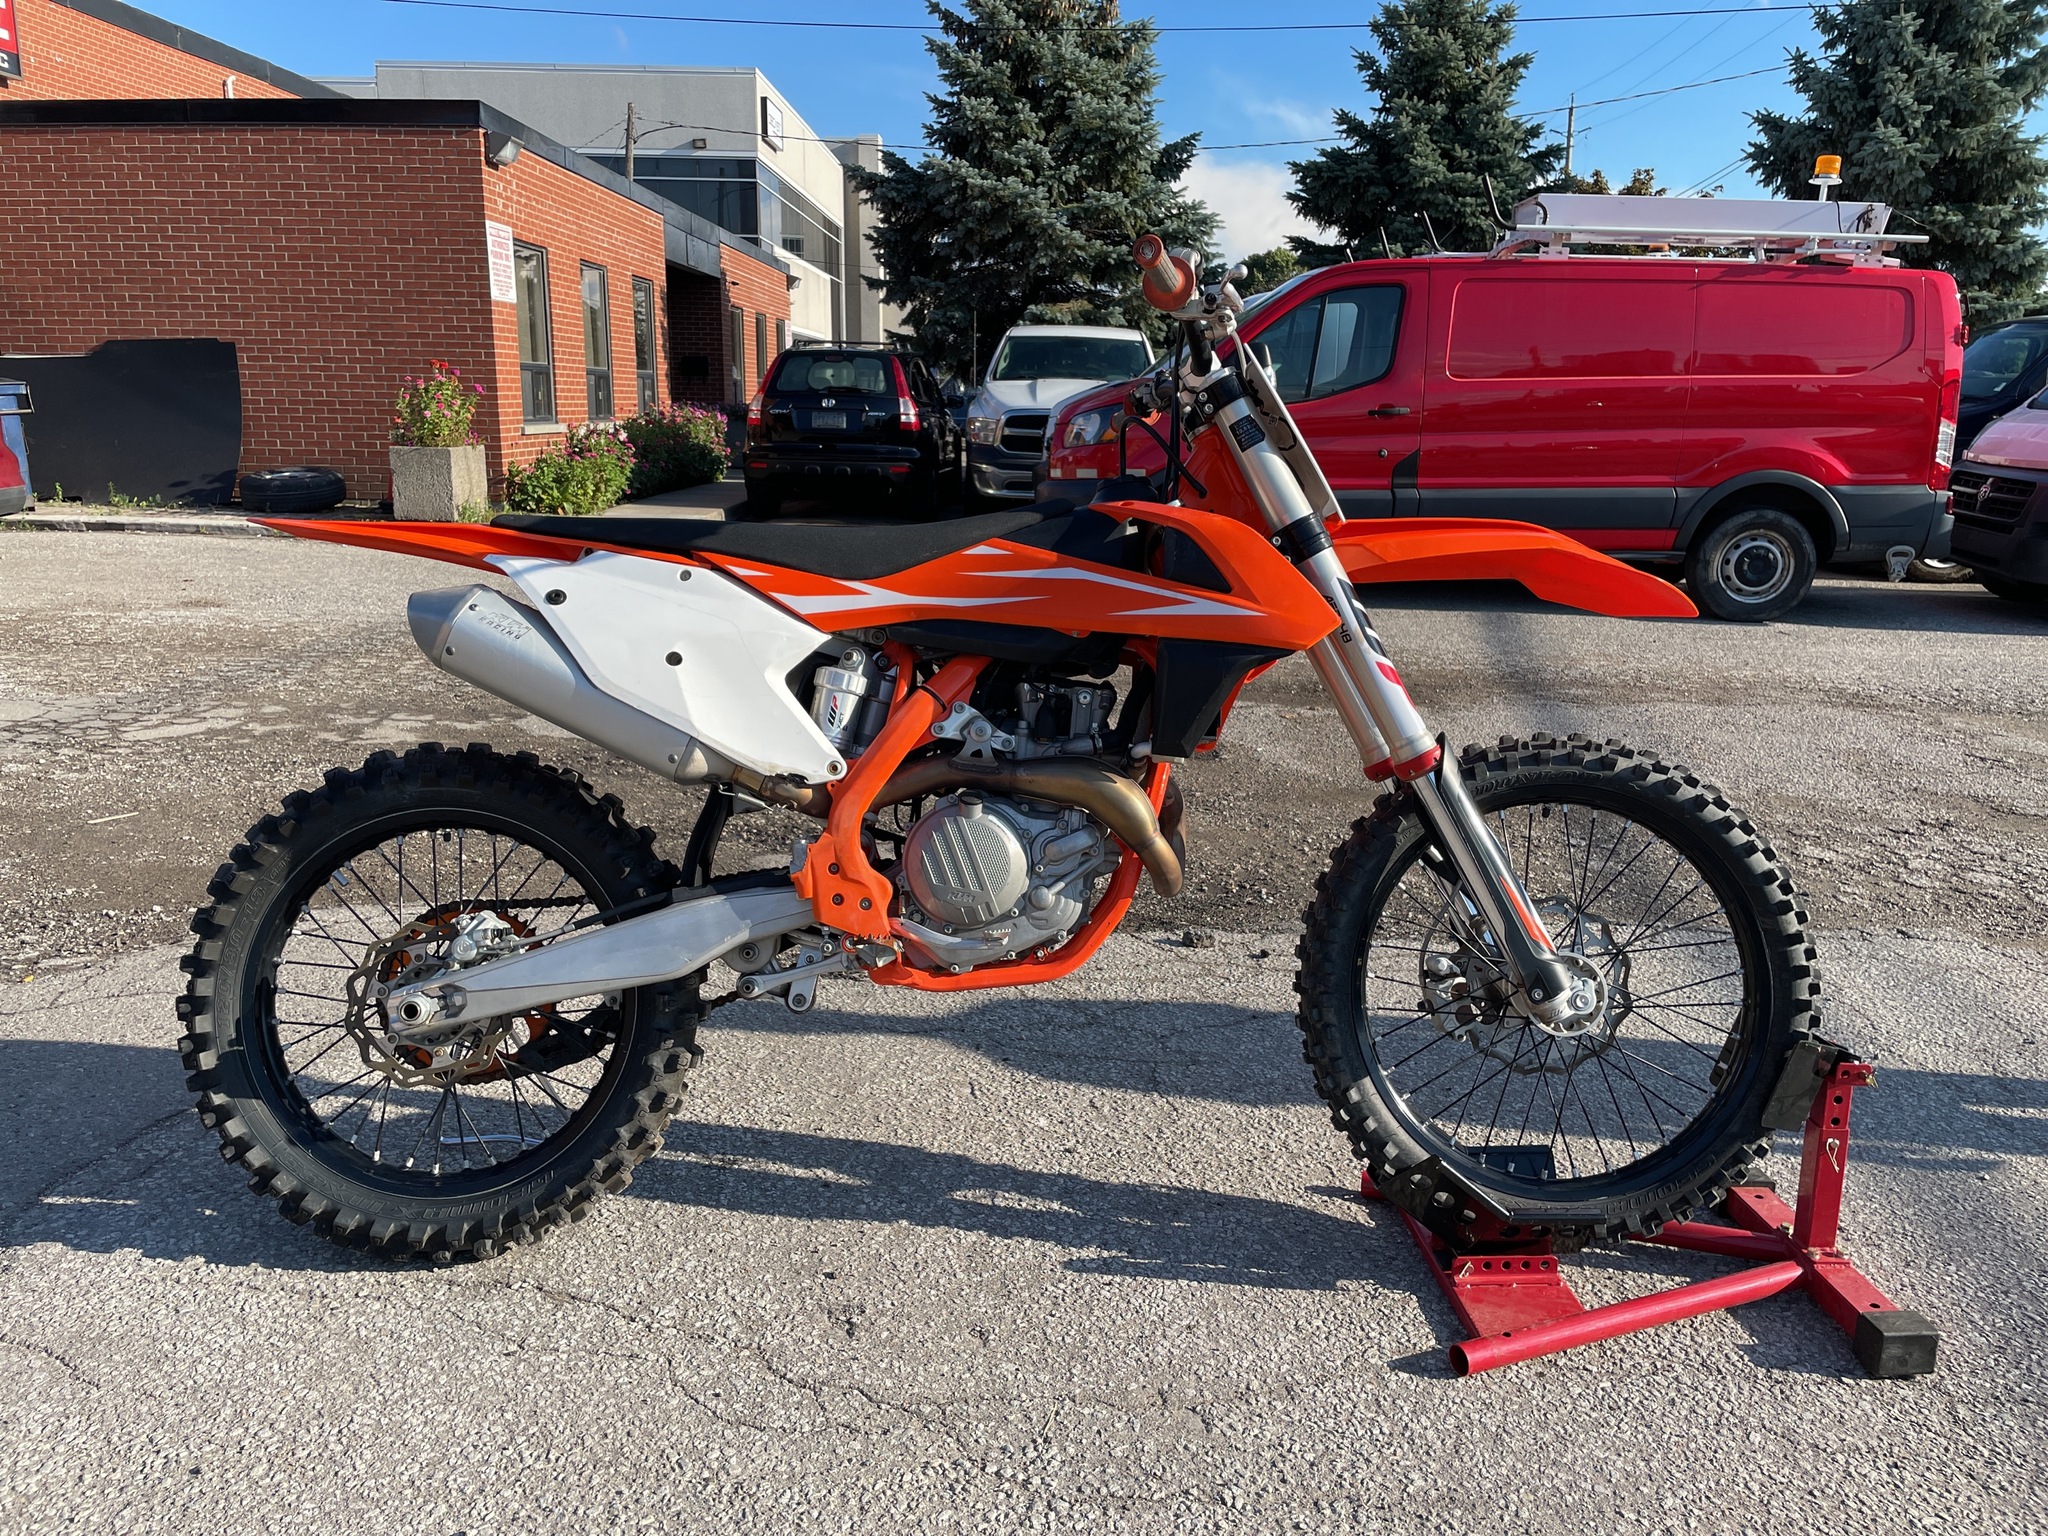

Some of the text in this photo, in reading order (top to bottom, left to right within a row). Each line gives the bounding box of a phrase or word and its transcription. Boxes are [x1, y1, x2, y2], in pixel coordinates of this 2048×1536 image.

[478, 616, 521, 640] RACING
[1339, 622, 1352, 643] 48
[947, 890, 976, 903] KTM
